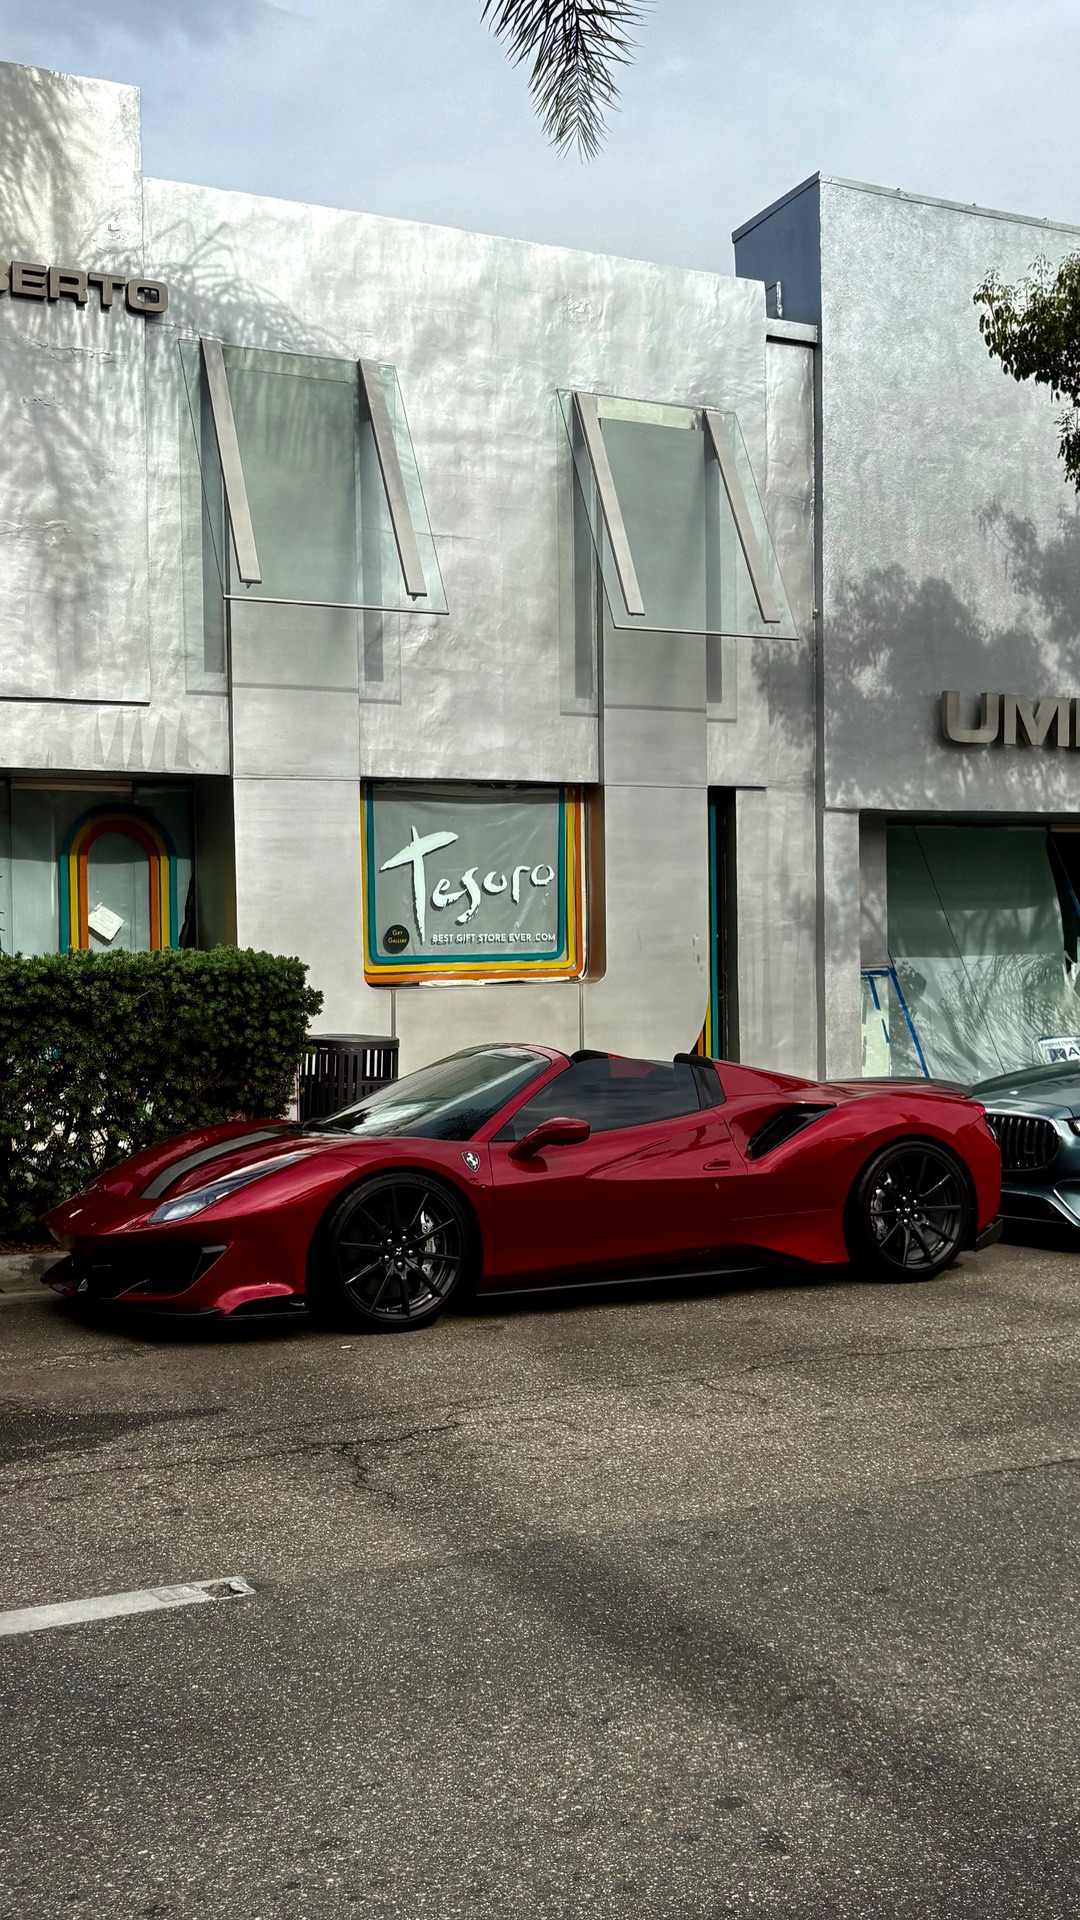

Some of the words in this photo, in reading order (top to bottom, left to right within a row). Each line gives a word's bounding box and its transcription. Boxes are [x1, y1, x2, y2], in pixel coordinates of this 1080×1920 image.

[0, 259, 169, 313] ERTO
[941, 690, 1080, 747] UM
[379, 825, 555, 942] Tesoro
[432, 933, 454, 942] BEST
[456, 933, 476, 942] GIFT
[479, 933, 507, 942] STORE
[509, 933, 532, 942] EVER
